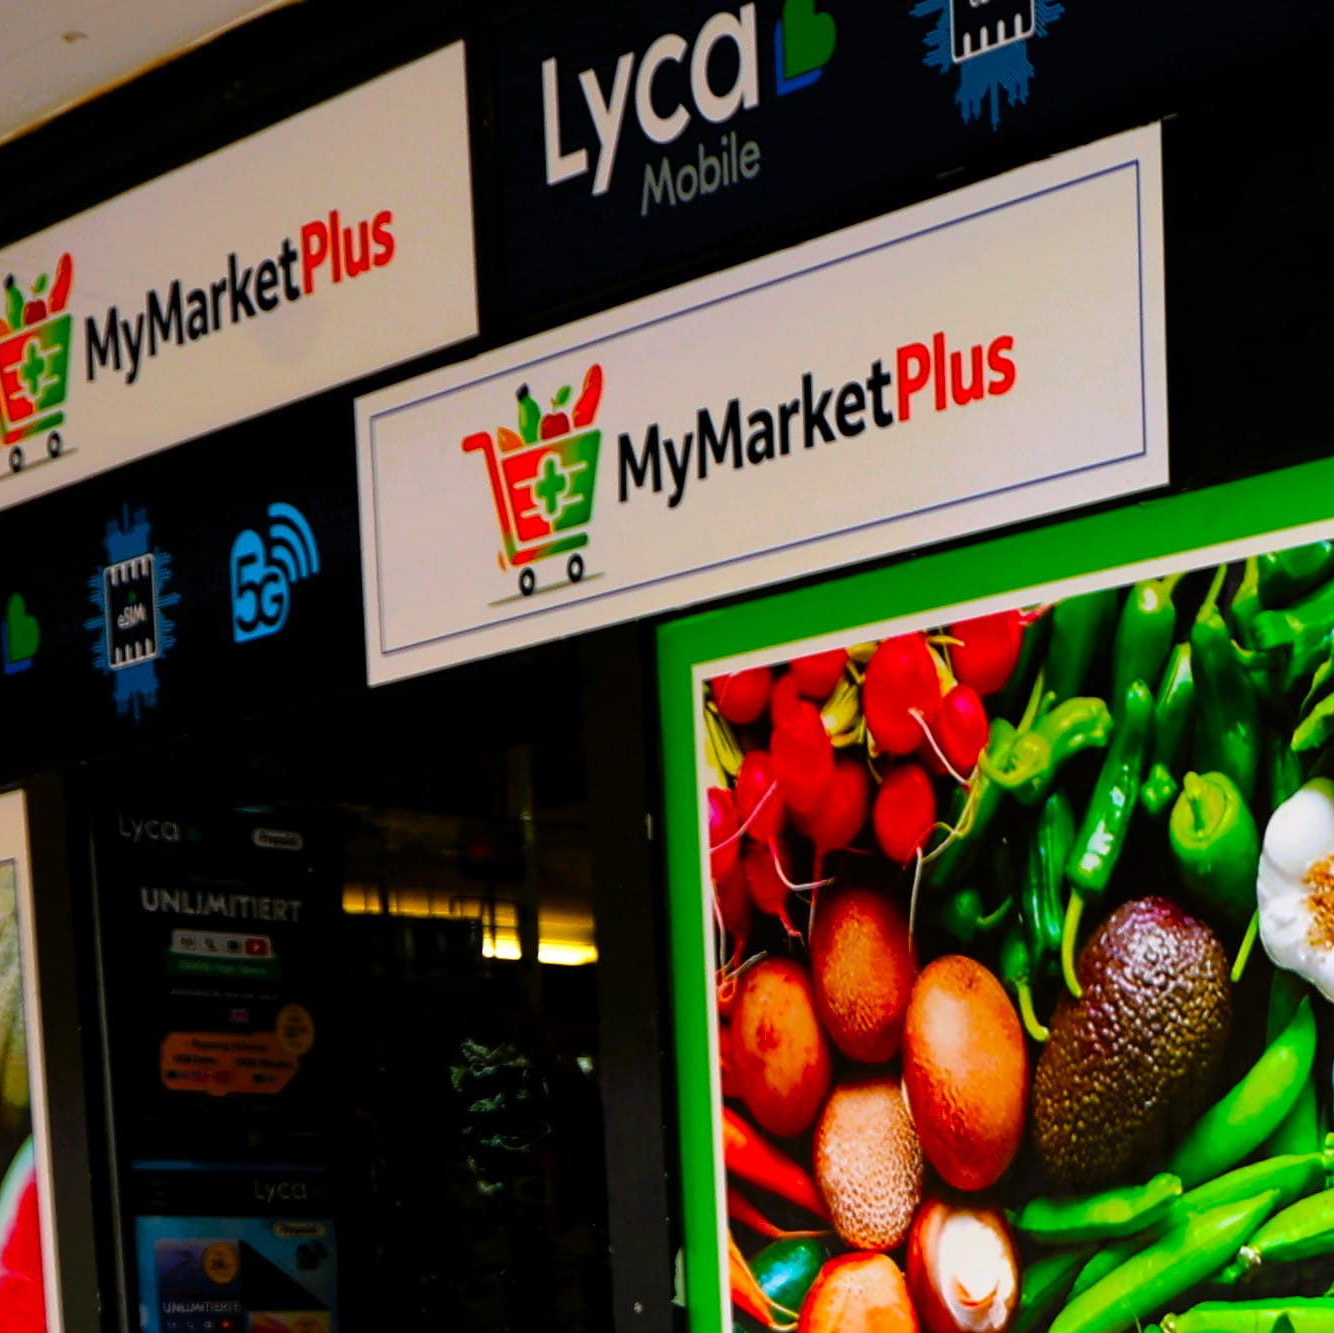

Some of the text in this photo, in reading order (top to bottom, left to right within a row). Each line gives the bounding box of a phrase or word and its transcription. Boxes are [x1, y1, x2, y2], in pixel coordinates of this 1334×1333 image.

[541, 1, 759, 196] Lyca
[640, 130, 762, 216] Mobile
[83, 208, 396, 386] MyMarketPlus
[617, 331, 1017, 508] MyMarketPlus
[236, 551, 286, 633] 5G
[118, 812, 181, 843] Lyca
[138, 886, 303, 923] UNLIMITIERT
